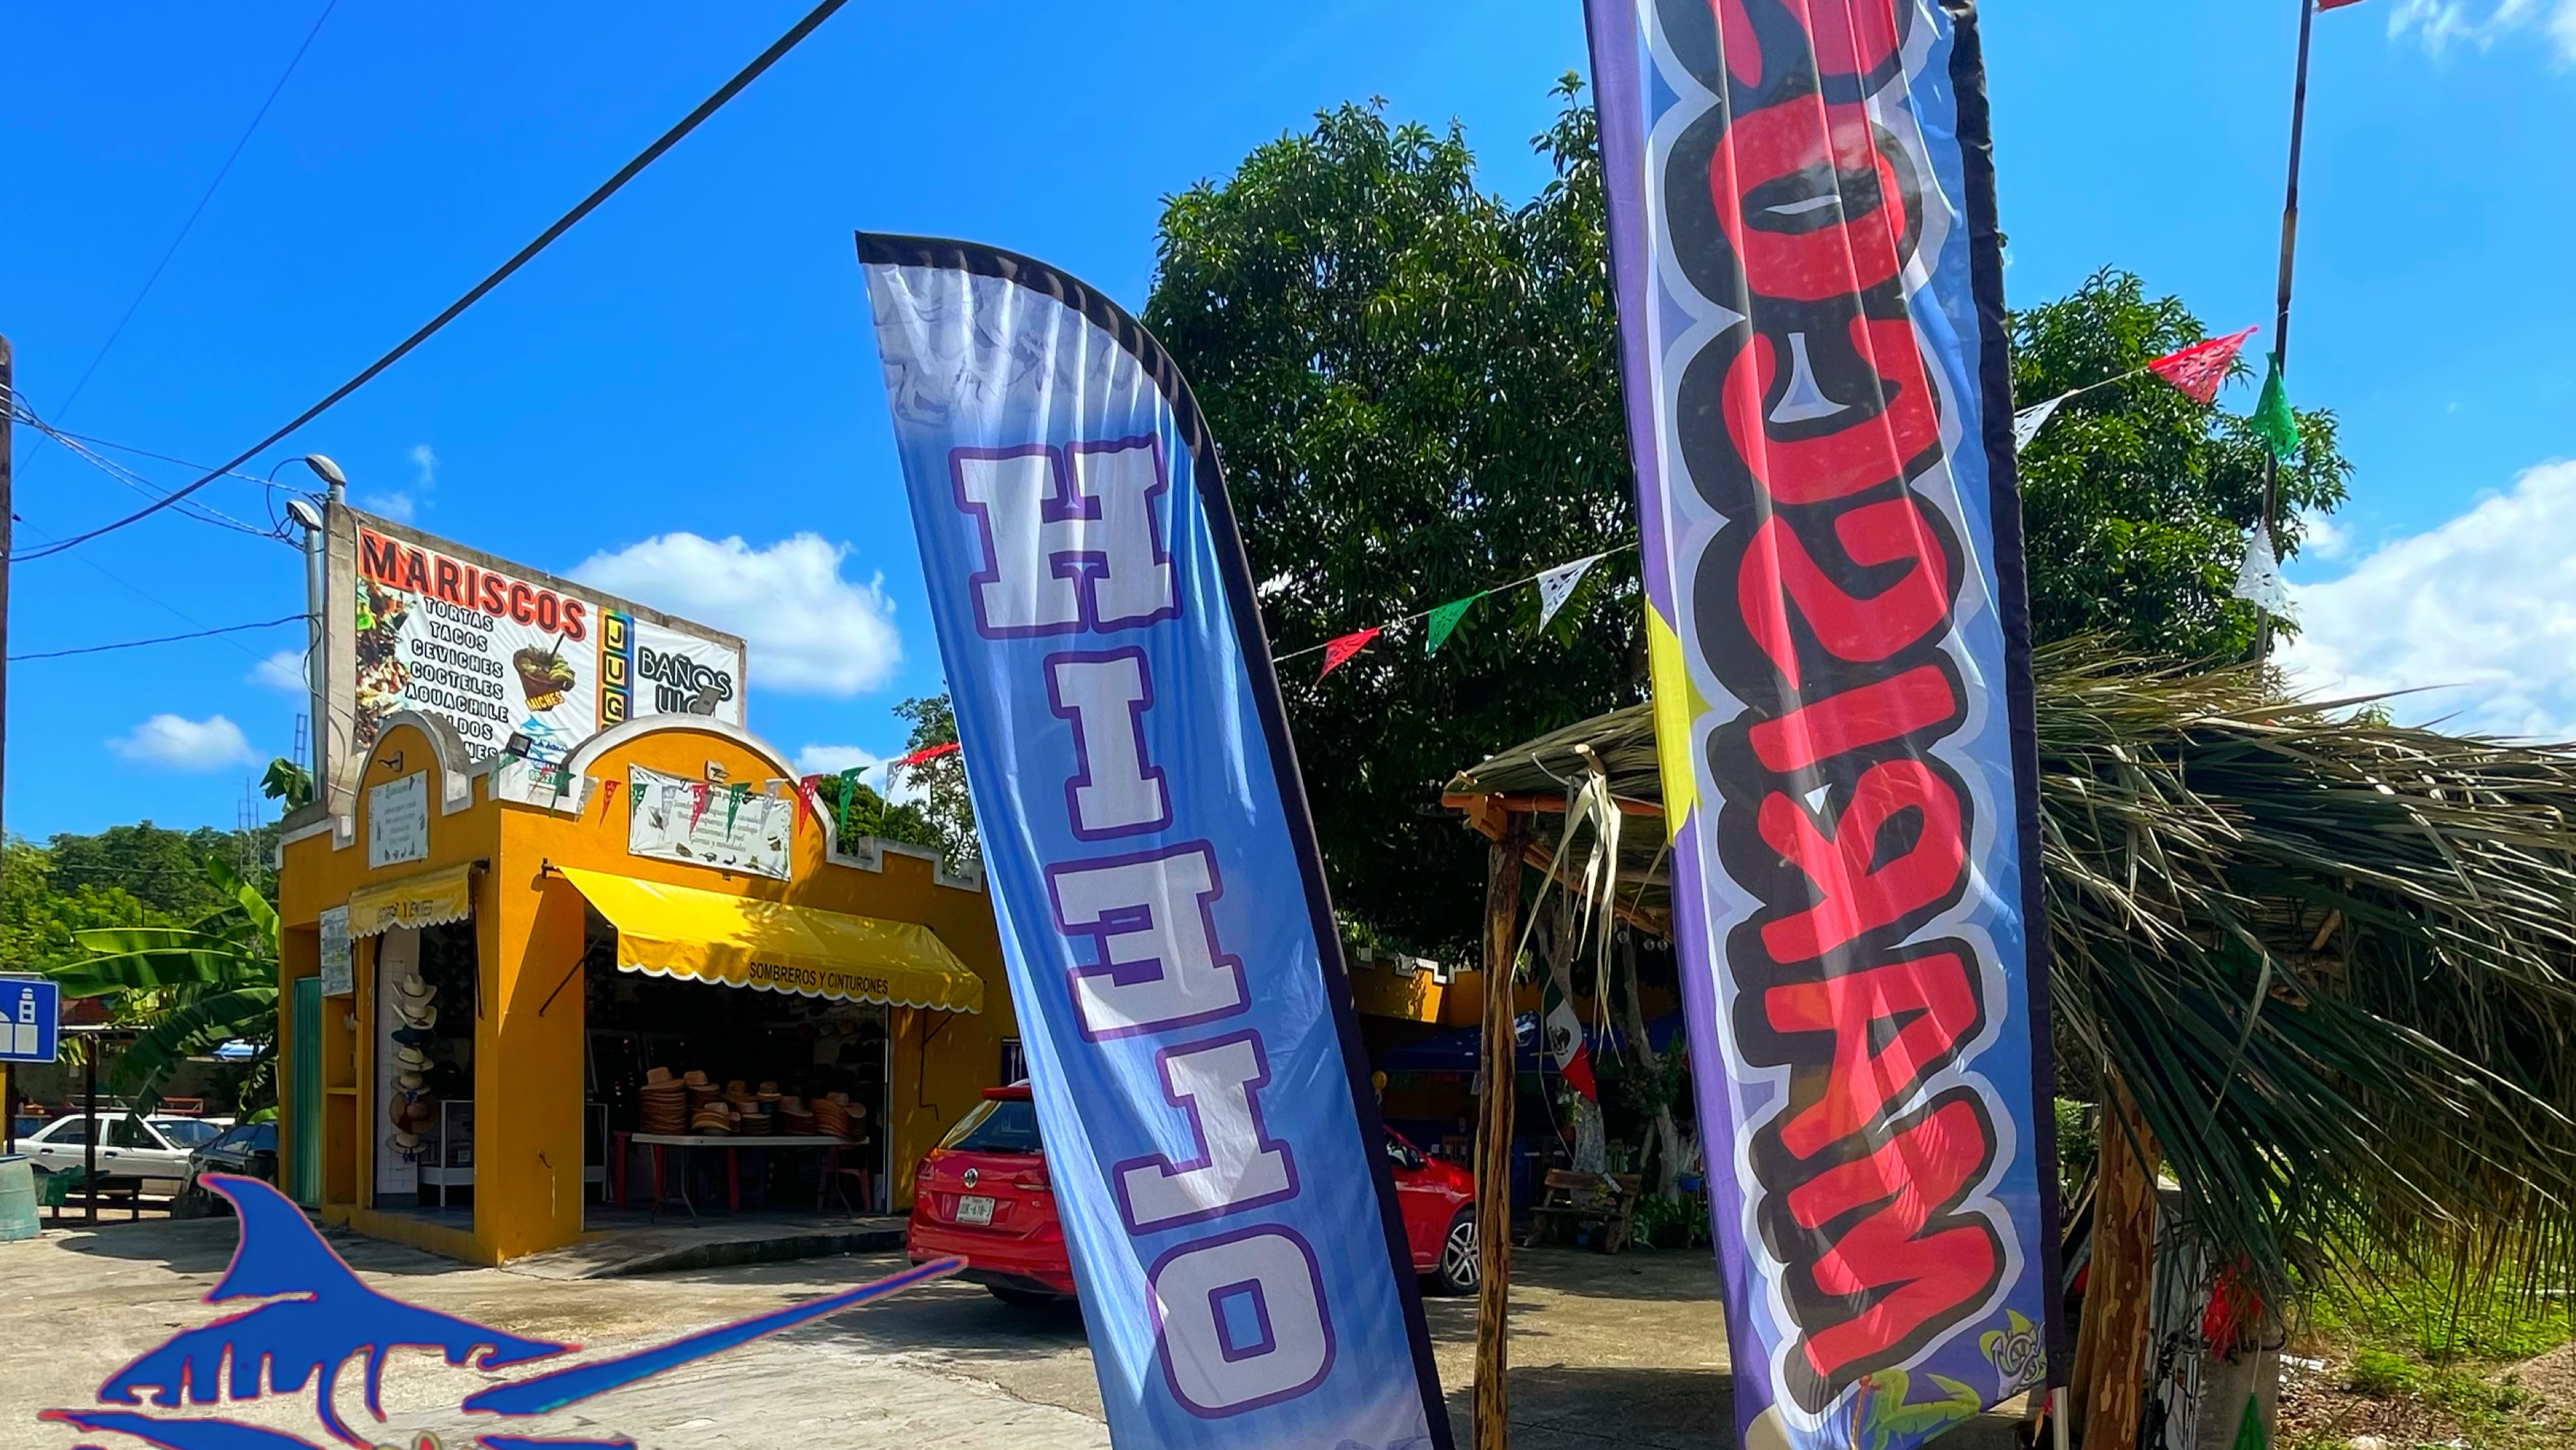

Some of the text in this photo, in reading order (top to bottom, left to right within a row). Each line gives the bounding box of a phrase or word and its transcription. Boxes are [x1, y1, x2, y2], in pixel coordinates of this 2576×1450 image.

[361, 528, 586, 640] MARISCOS
[424, 597, 493, 632] TORTAS
[430, 621, 487, 652] TACOS
[411, 638, 504, 678] CEVICHES
[605, 620, 626, 719] JUG
[639, 646, 733, 702] BAÑOS
[410, 661, 504, 700] COCTELES
[405, 682, 510, 723] AGUACHILE
[526, 691, 565, 711] MICHES
[464, 741, 499, 760] NES
[750, 962, 888, 995] SOMBREROS Y CINTURONES
